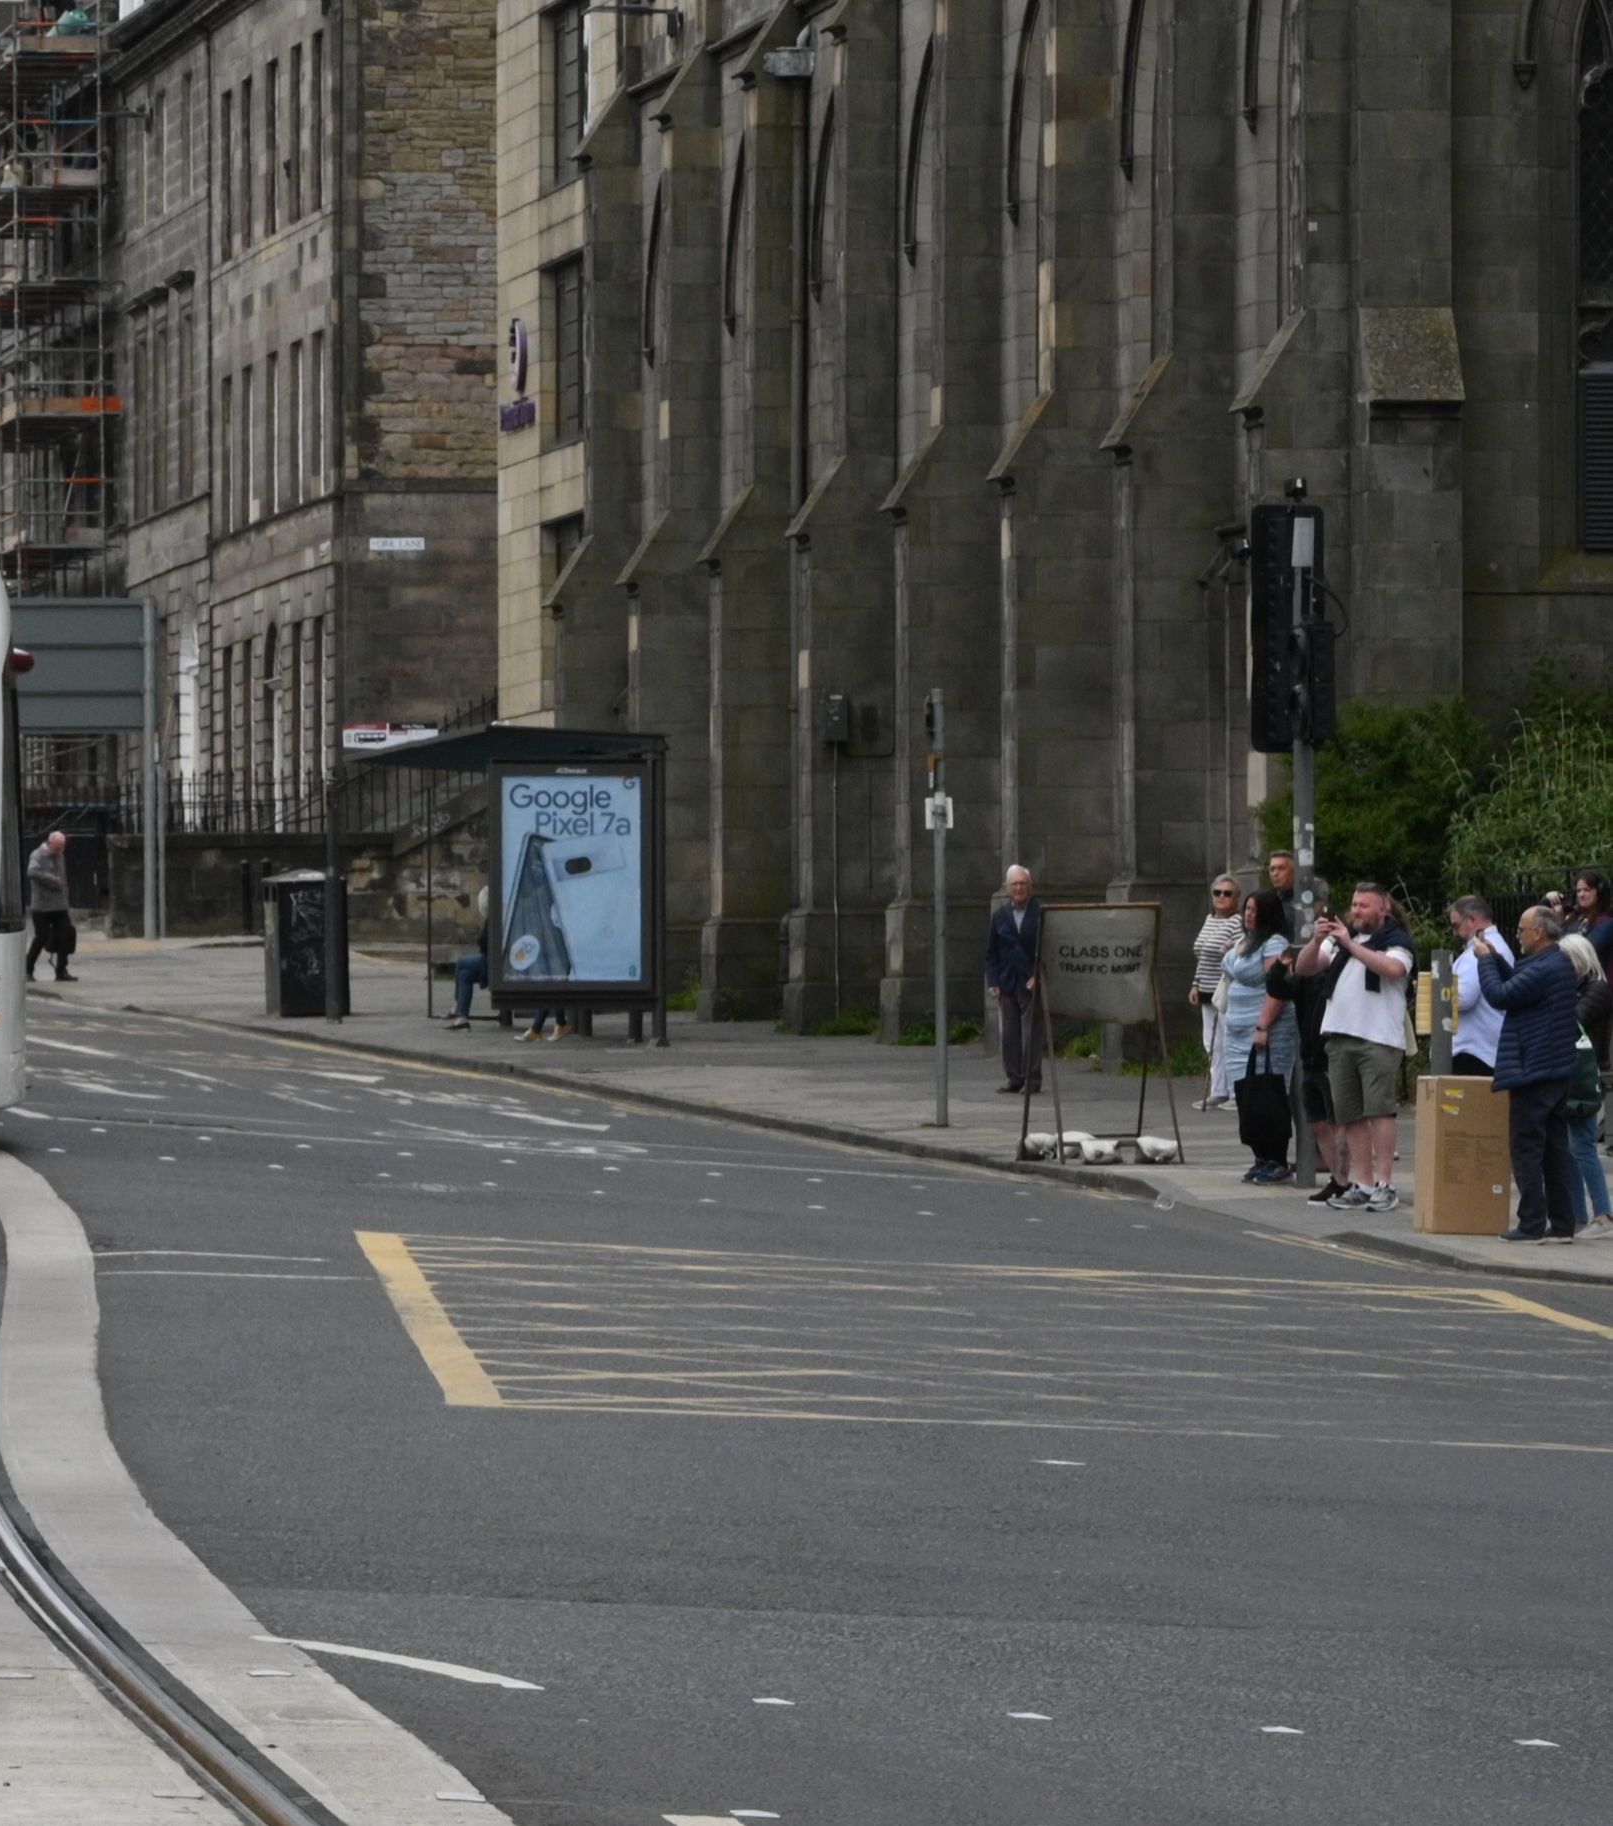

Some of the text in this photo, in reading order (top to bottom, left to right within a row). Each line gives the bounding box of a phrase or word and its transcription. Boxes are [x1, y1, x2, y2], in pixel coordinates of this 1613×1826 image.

[509, 783, 612, 815] Google
[535, 811, 632, 836] Pixel 7a
[1058, 944, 1144, 958] CLASS ONE
[1058, 962, 1108, 975] TRAFFIC
